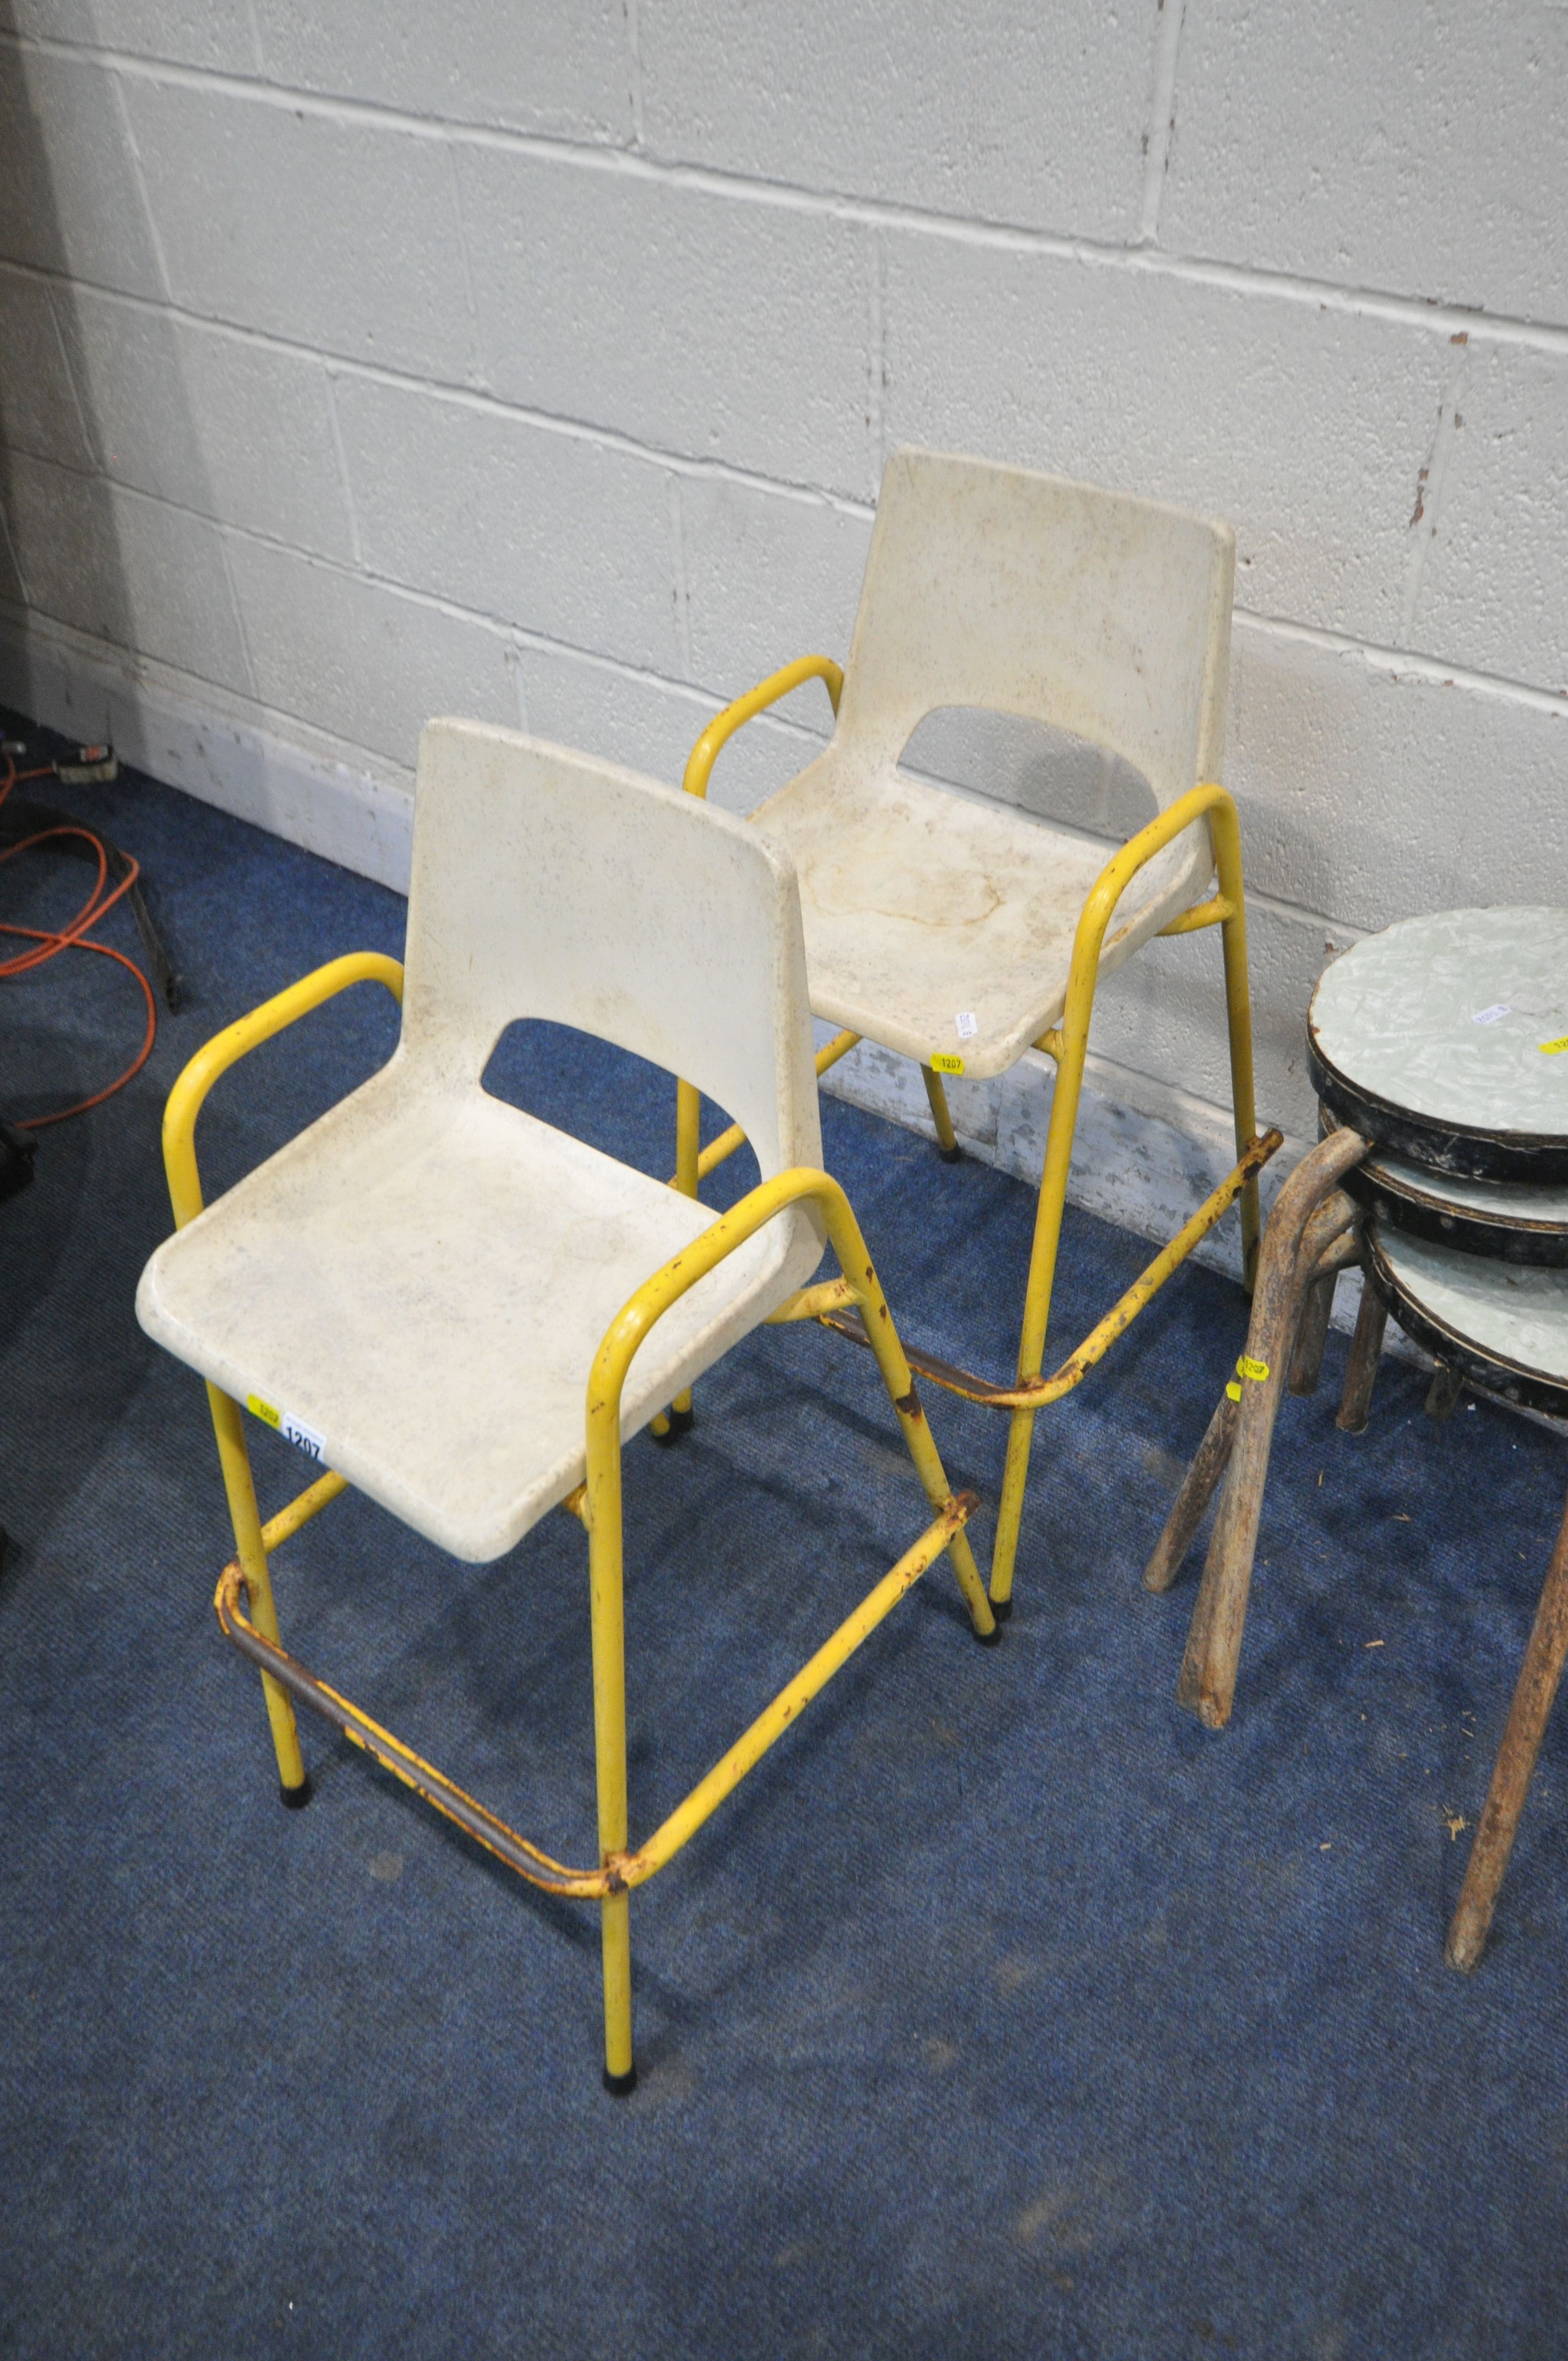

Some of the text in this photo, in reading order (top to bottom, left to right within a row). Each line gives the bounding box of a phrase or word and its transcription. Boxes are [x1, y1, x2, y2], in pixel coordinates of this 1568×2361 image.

[1554, 1039, 1568, 1048] 12
[942, 1058, 961, 1069] 1207
[1245, 1359, 1265, 1374] 1207
[286, 1427, 320, 1460] 1207
